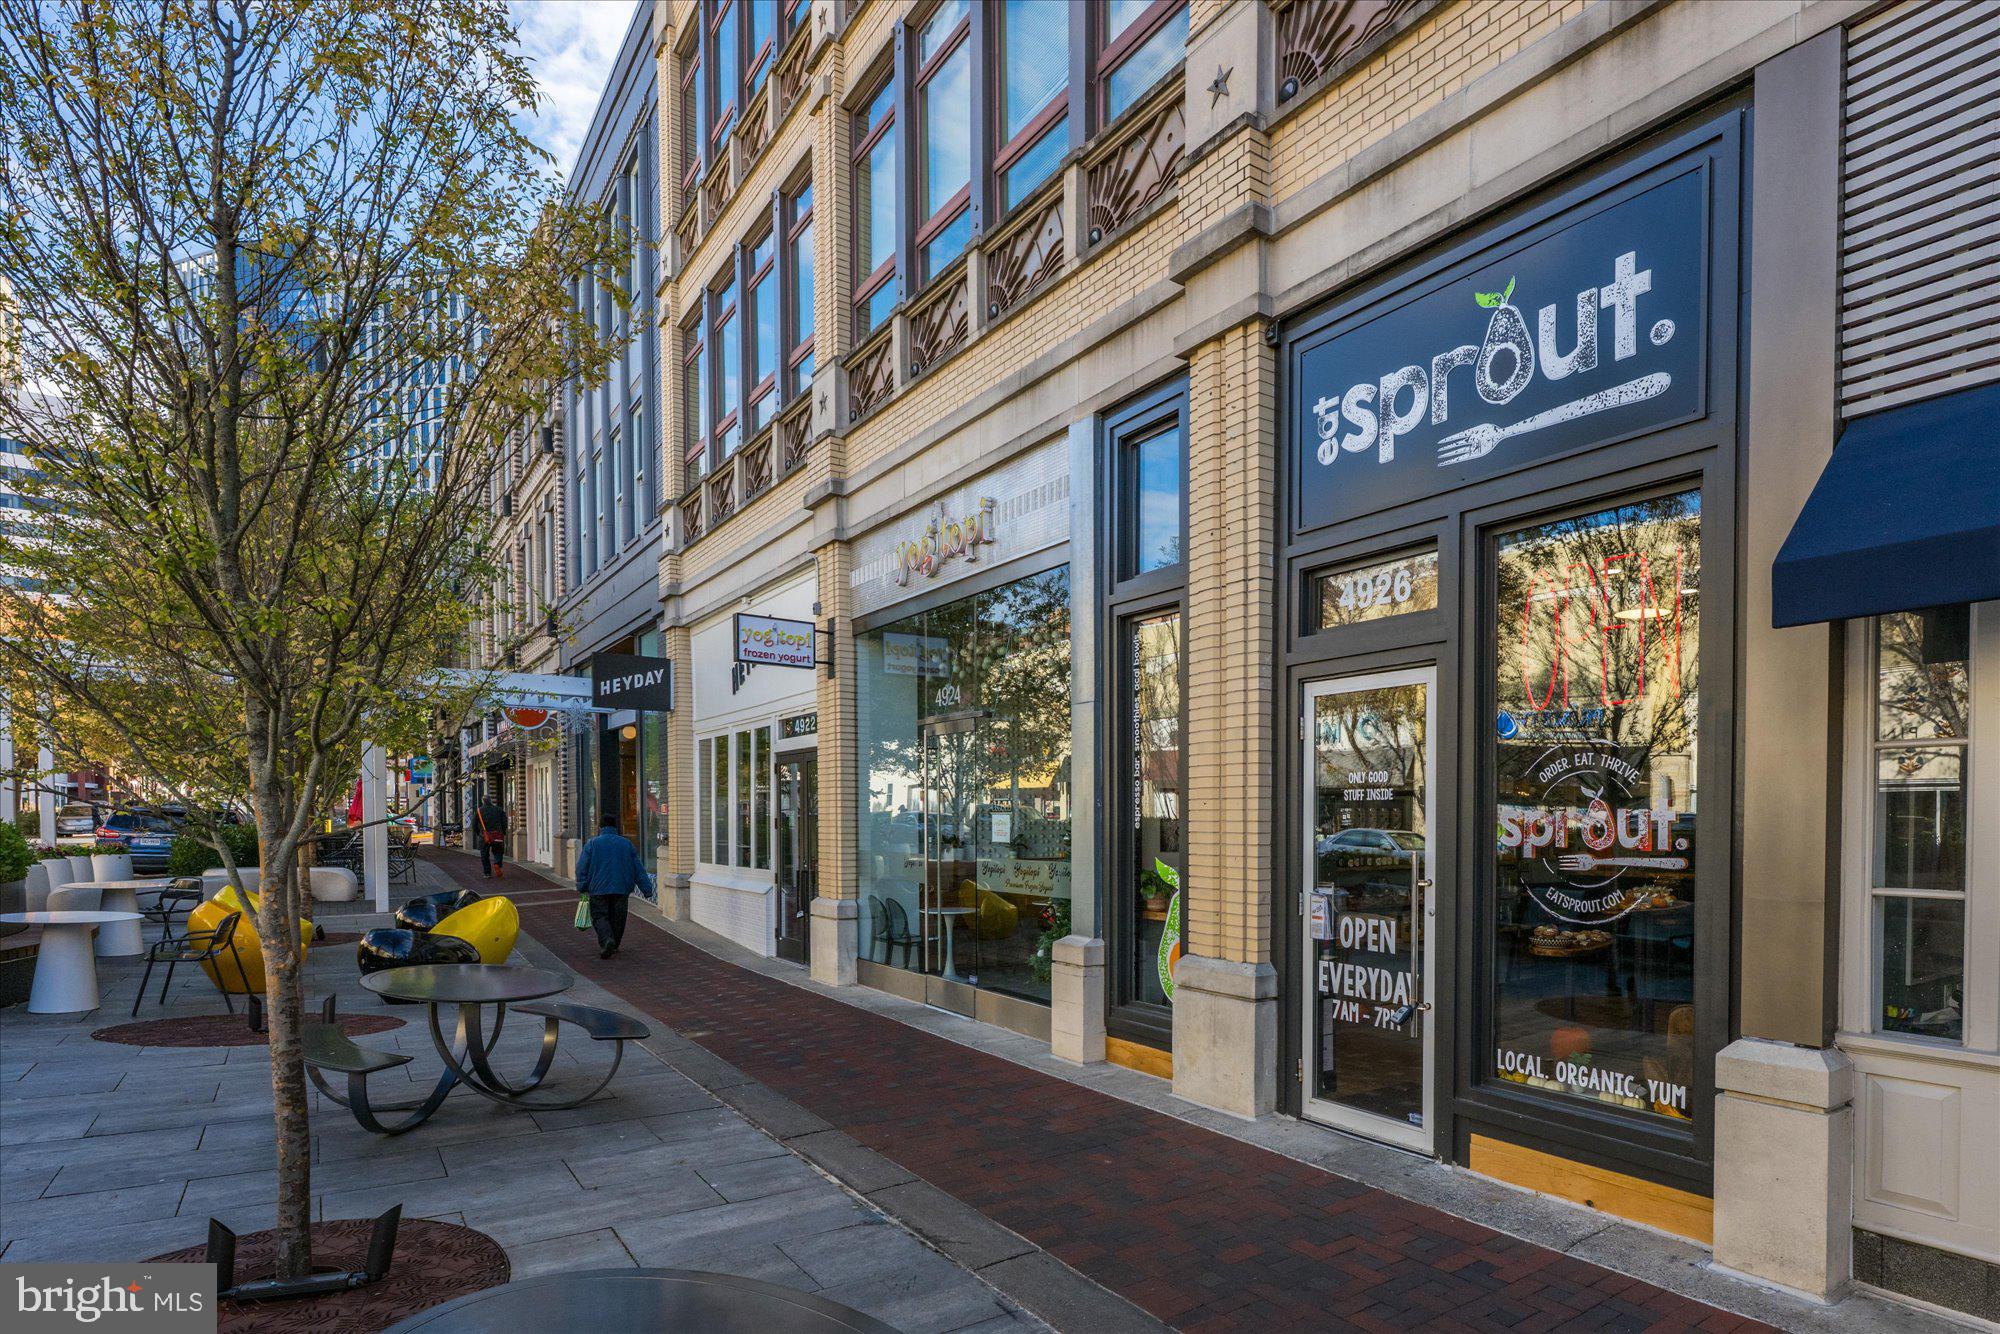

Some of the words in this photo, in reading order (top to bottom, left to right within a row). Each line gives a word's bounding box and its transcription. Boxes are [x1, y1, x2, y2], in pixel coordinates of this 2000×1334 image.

[1313, 396, 1340, 466] eat
[1339, 569, 1412, 611] 4926
[1523, 547, 1682, 711] OPEN
[743, 648, 775, 659] frozen
[778, 653, 811, 664] yogurt
[600, 669, 664, 696] HEYDAY
[936, 685, 961, 707] 4924
[795, 716, 816, 733] 4922
[1133, 755, 1141, 777] bar.
[1348, 772, 1366, 784] ONLY
[1368, 771, 1388, 783] GOOD
[1539, 758, 1571, 783] ORDER.
[1575, 752, 1596, 767] EAT.
[1601, 754, 1640, 785] THRIVE.
[1133, 780, 1142, 829] espresso
[1343, 789, 1365, 801] STUFF
[1366, 788, 1393, 801] INSIDE
[1545, 886, 1625, 913] EATSPROUT.COM
[1339, 916, 1396, 955] OPEN
[1332, 999, 1359, 1024] 7AM
[1497, 1049, 1549, 1079] LOCAL.
[1555, 1061, 1640, 1099] ORGANIC.
[1648, 1079, 1686, 1109] YUM
